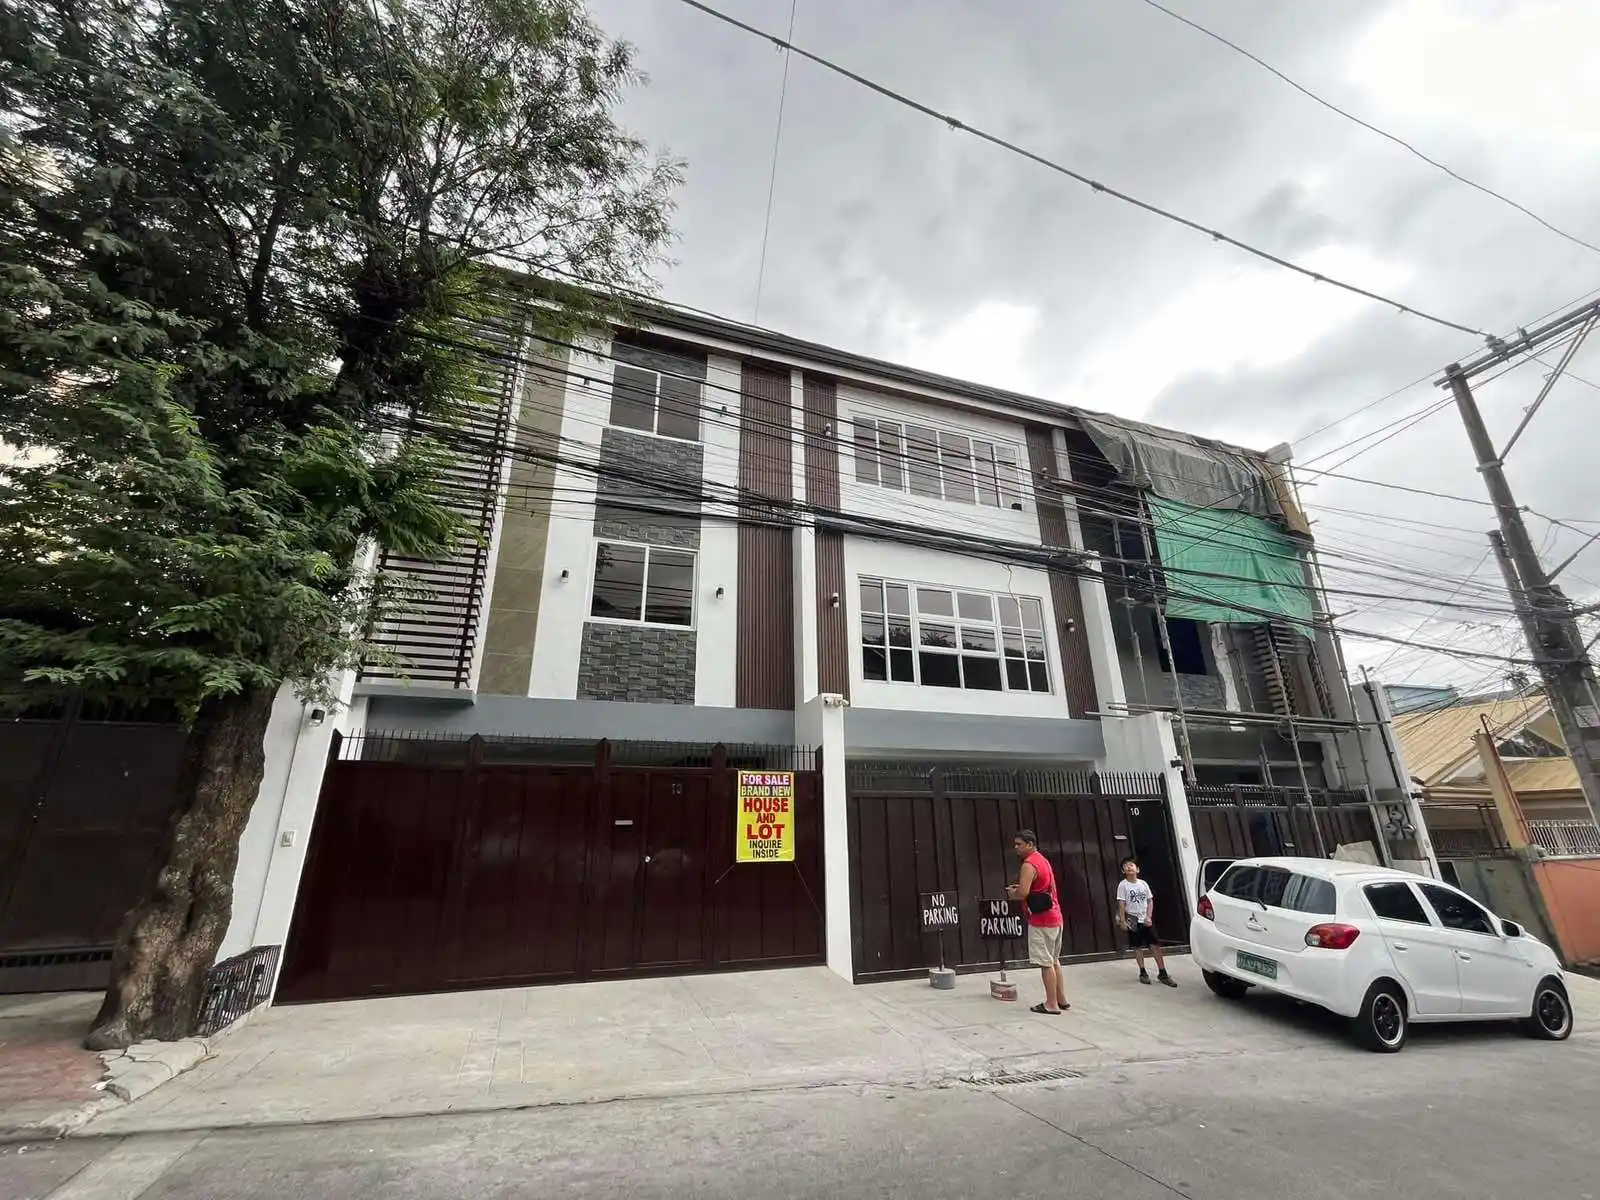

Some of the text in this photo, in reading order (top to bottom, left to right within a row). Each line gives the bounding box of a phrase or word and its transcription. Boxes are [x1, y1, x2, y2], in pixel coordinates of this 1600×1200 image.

[742, 774, 789, 785] FOR SALE
[741, 785, 791, 796] BRAND NEW
[743, 797, 789, 812] HOUSE
[756, 812, 776, 823] AND
[746, 824, 785, 839] LOT
[749, 840, 782, 848] INQUIRE
[752, 849, 779, 858] INSIDE
[931, 893, 945, 907] NO
[990, 900, 1009, 915] NO
[923, 906, 959, 926] PARKING
[980, 916, 1023, 936] PARKING
